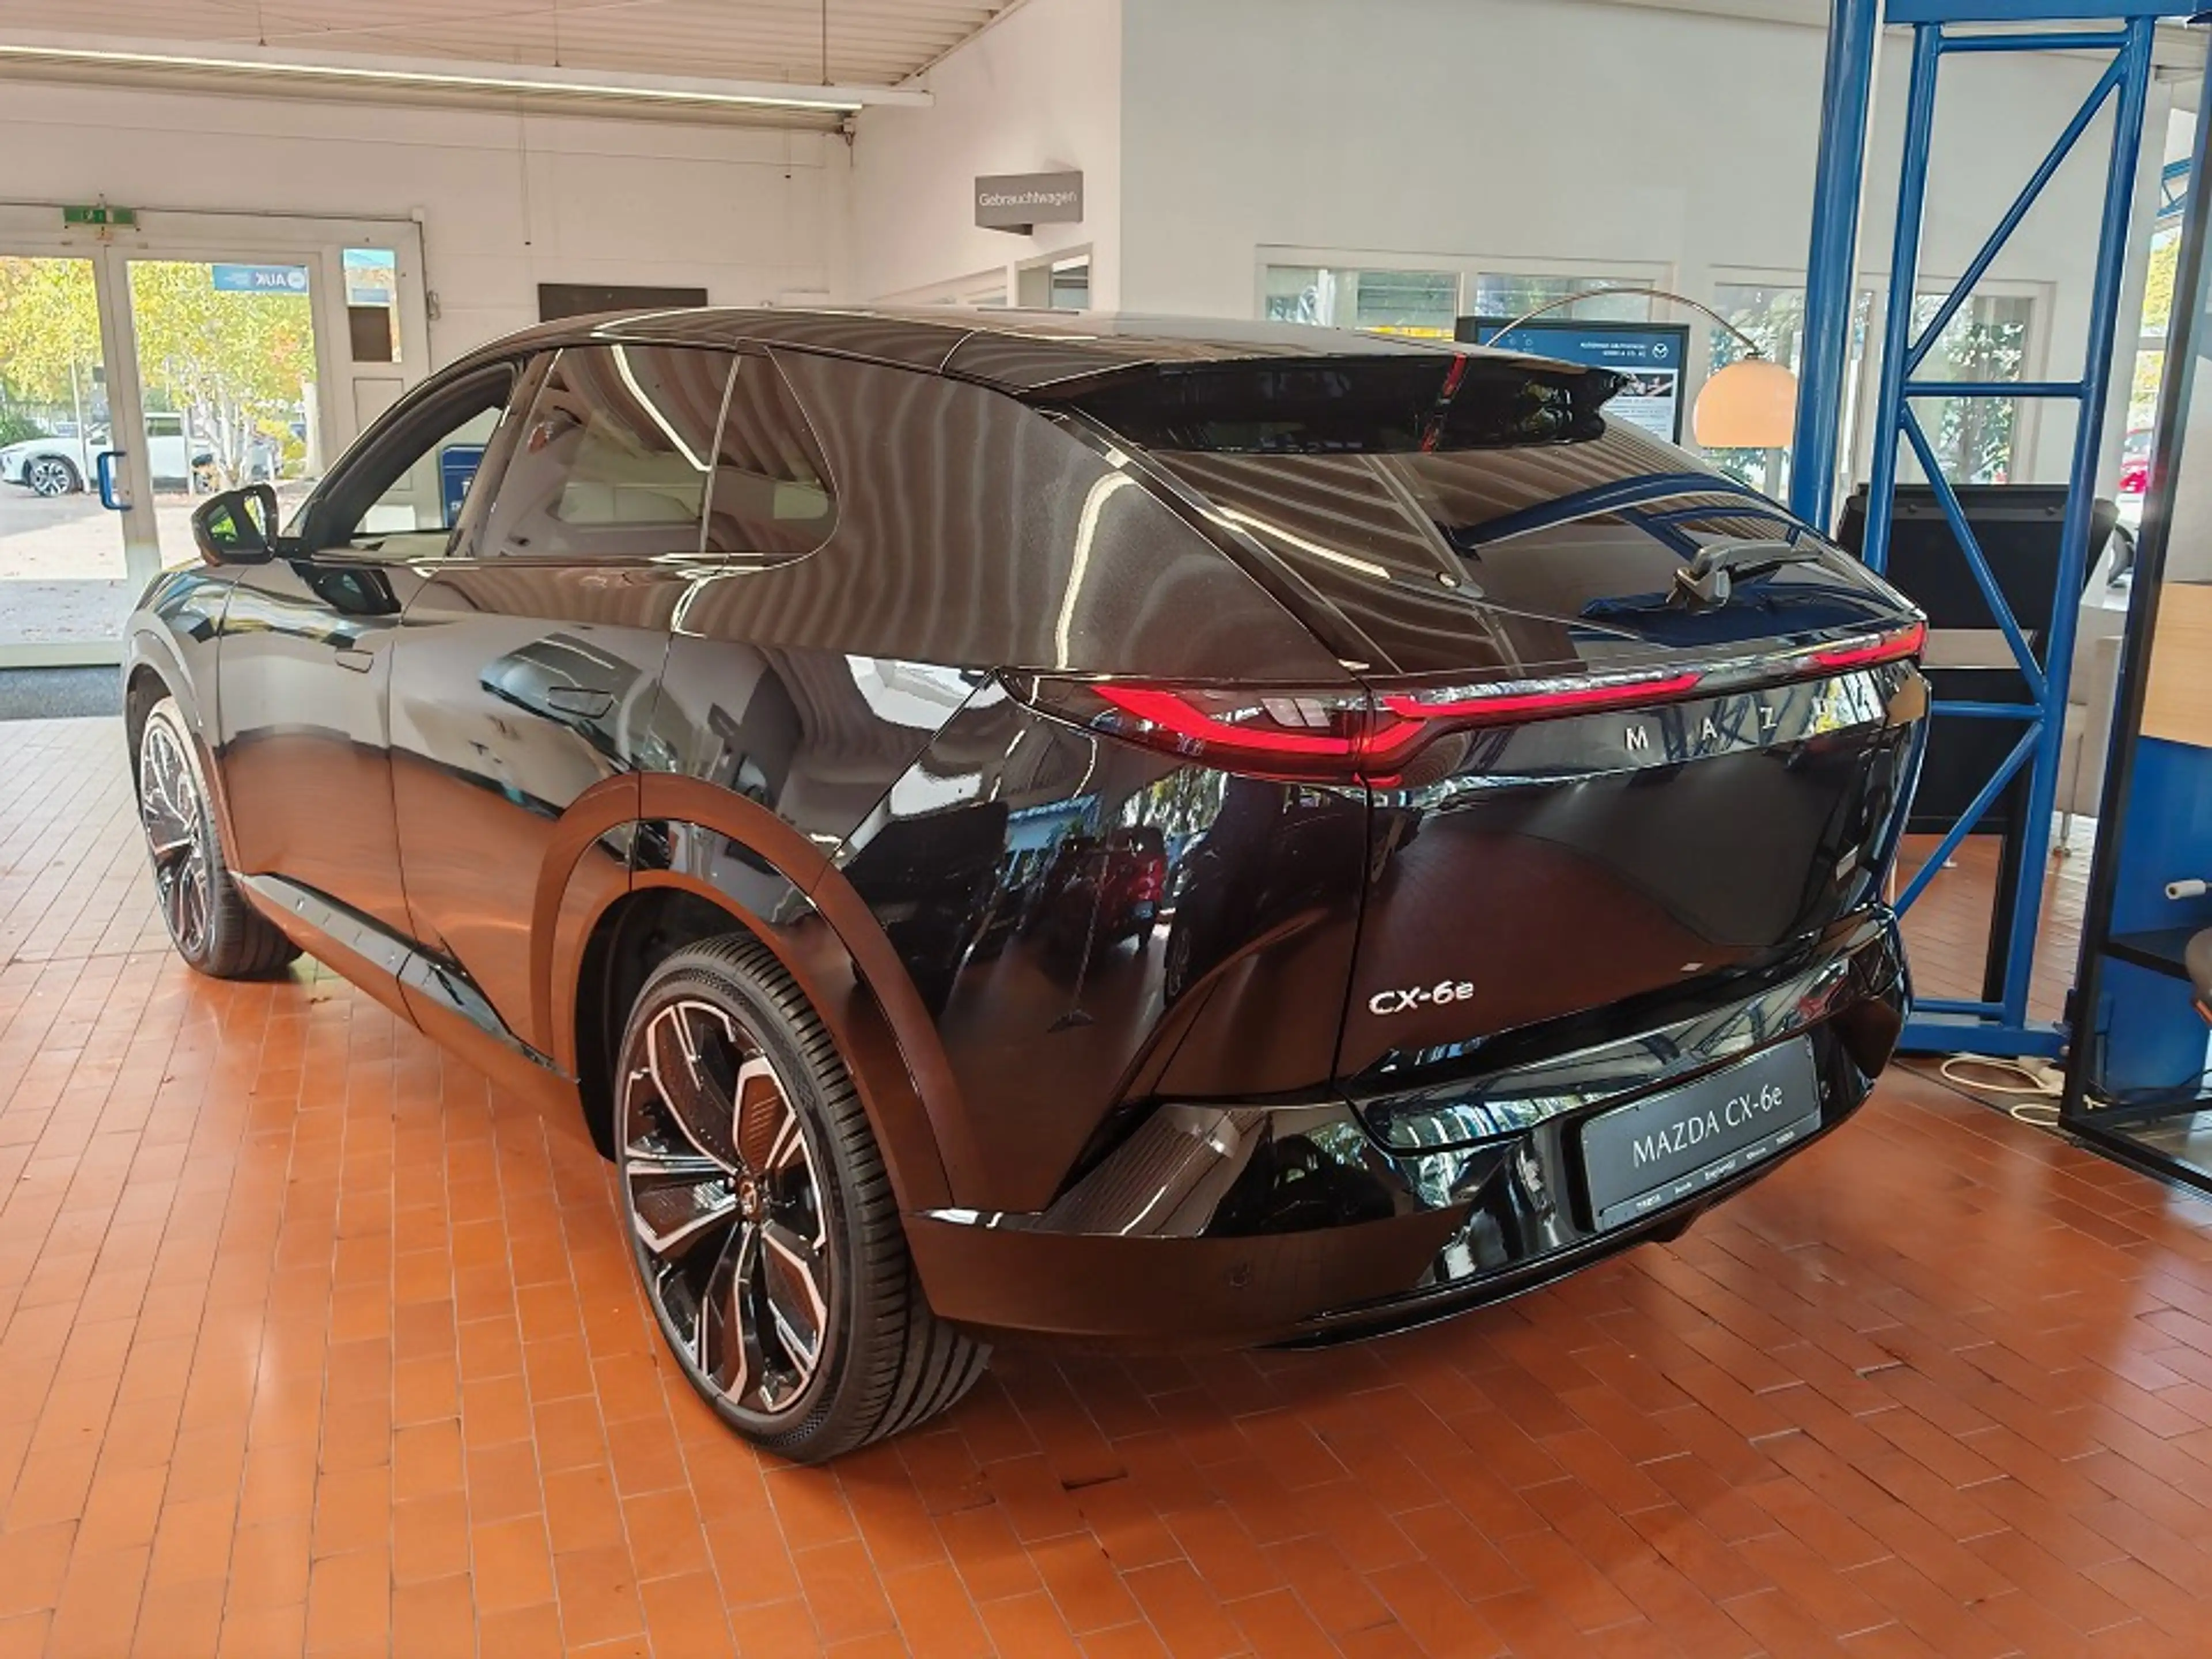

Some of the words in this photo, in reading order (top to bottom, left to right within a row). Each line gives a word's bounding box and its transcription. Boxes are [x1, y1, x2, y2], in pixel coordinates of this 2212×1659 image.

[979, 191, 1077, 206] Gebrauchtwagen
[1369, 980, 1474, 1014] CX-6e
[1633, 1110, 1720, 1168] MAZDA
[1725, 1084, 1782, 1127] CX-6e
